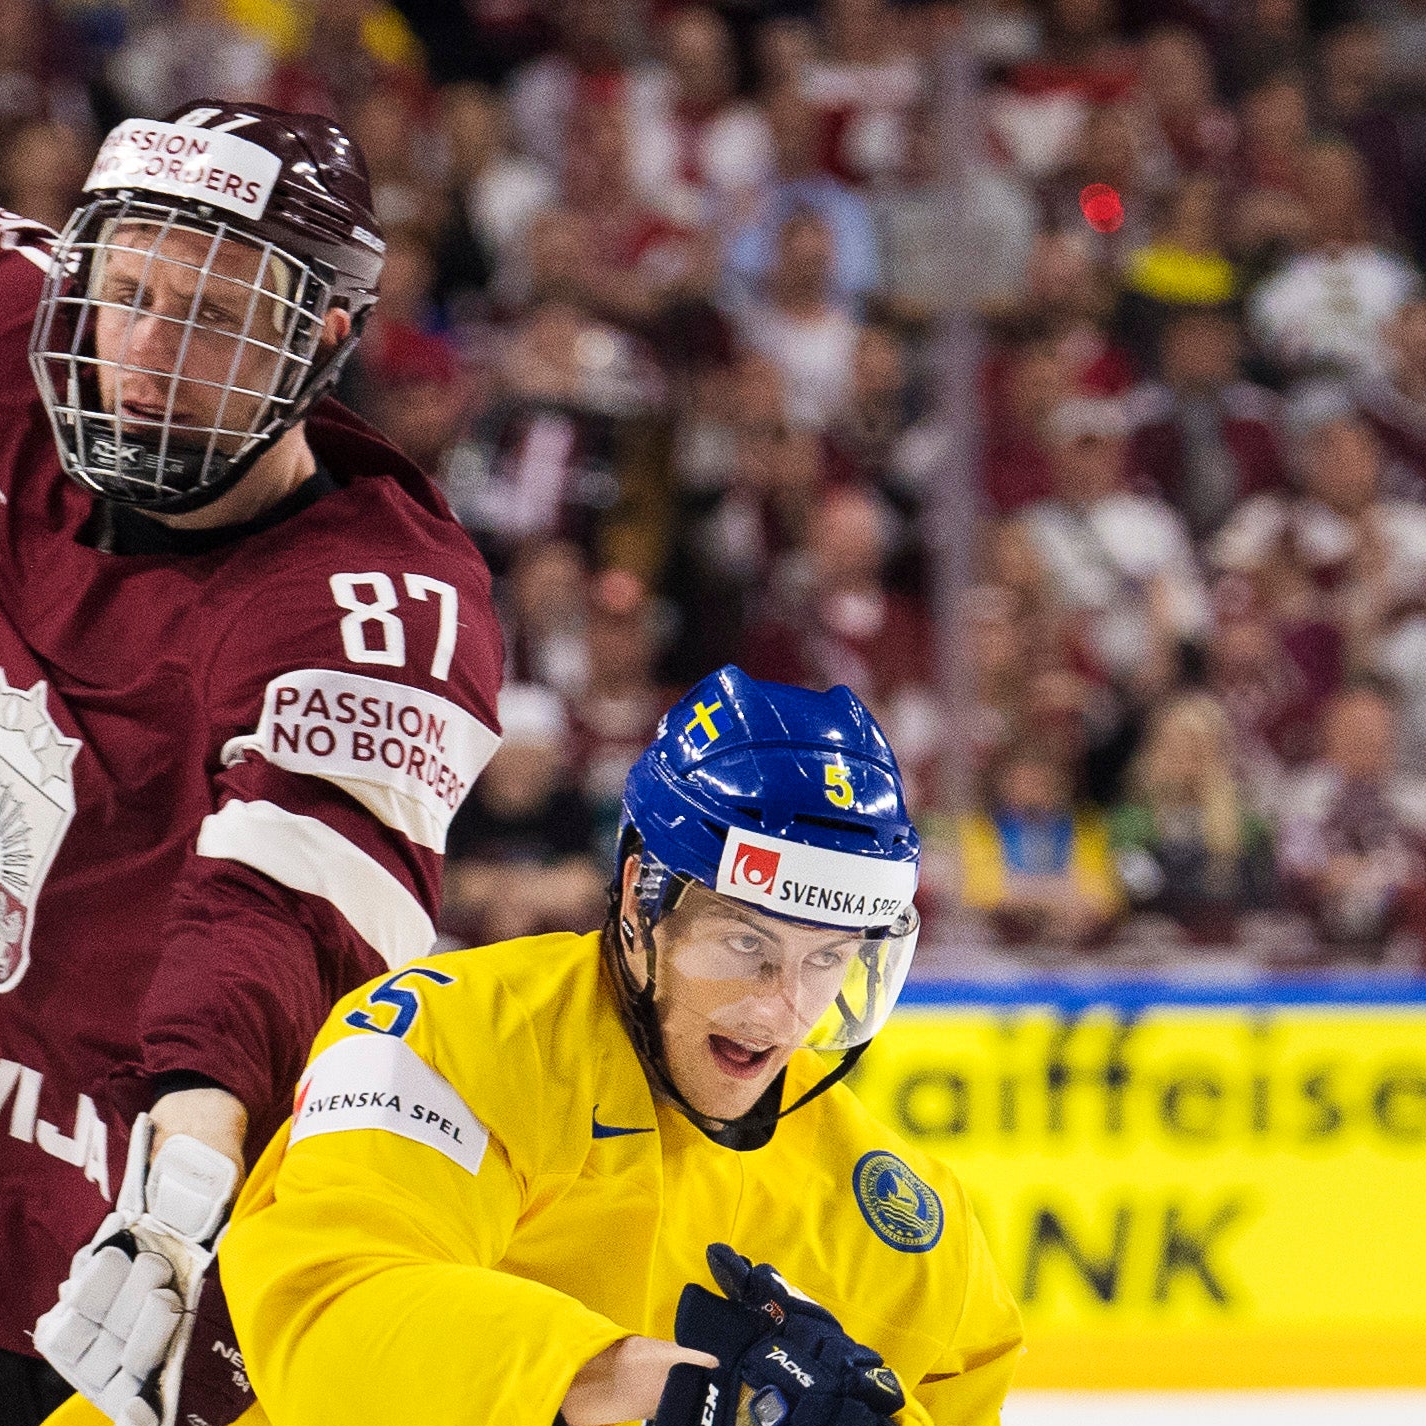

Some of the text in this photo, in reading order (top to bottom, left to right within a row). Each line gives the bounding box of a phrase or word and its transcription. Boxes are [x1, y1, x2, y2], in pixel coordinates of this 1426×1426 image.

[329, 571, 458, 681] 87
[272, 722, 336, 757] NO
[824, 764, 855, 811] 5
[779, 880, 902, 917] SVENSKA SPEL
[345, 968, 454, 1038] 5
[306, 1092, 463, 1144] SVENSKA SPEL
[765, 1345, 815, 1388] TACKS
